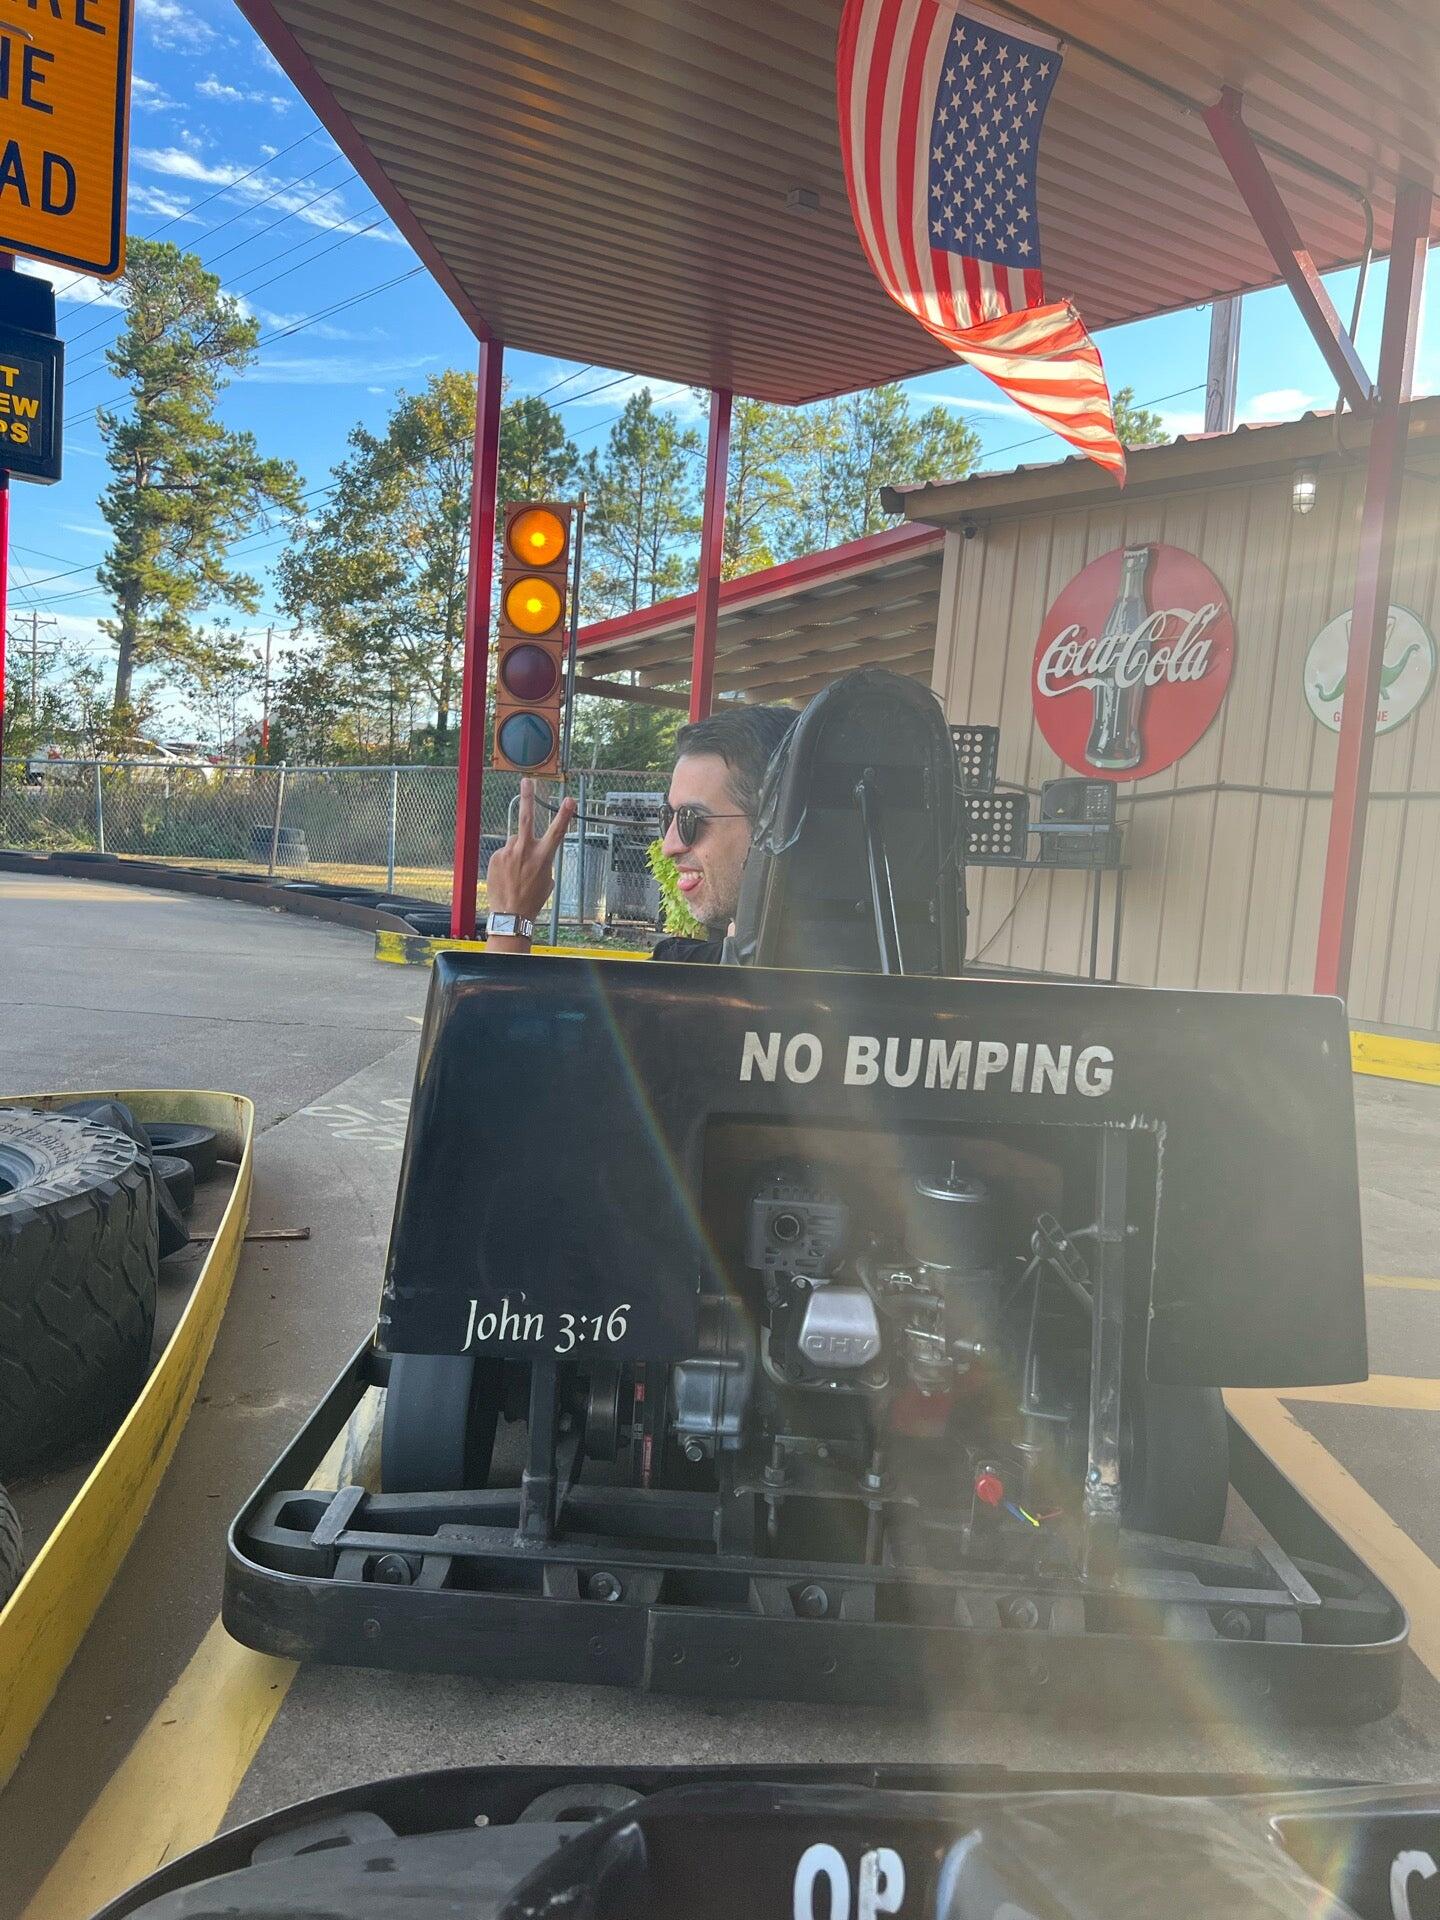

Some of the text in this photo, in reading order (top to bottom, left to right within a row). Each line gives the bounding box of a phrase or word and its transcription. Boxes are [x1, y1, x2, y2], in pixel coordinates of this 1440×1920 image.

[0, 139, 76, 215] AD
[739, 1031, 1115, 1098] NO BUMPING
[460, 1299, 632, 1353] John 3:16
